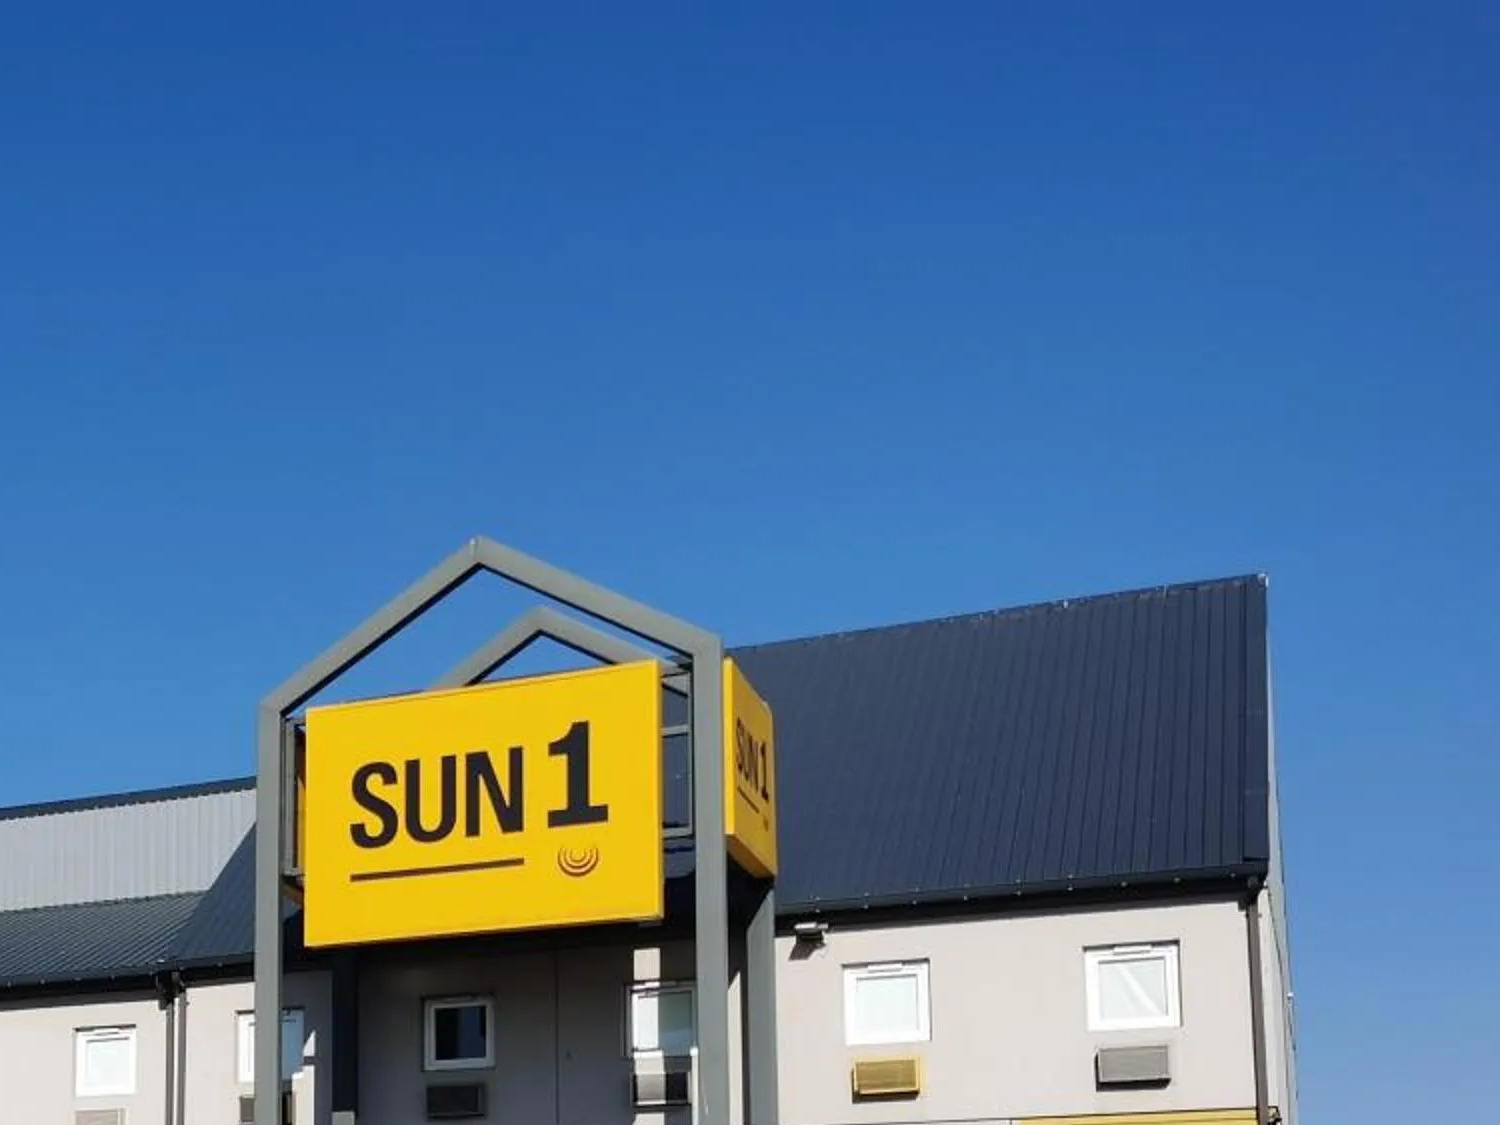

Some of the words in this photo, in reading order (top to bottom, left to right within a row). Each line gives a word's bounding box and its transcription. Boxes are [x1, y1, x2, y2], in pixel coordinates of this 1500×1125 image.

[350, 746, 524, 849] SUN
[547, 721, 609, 828] 1
[735, 717, 759, 793] SUN
[759, 741, 770, 804] 1
